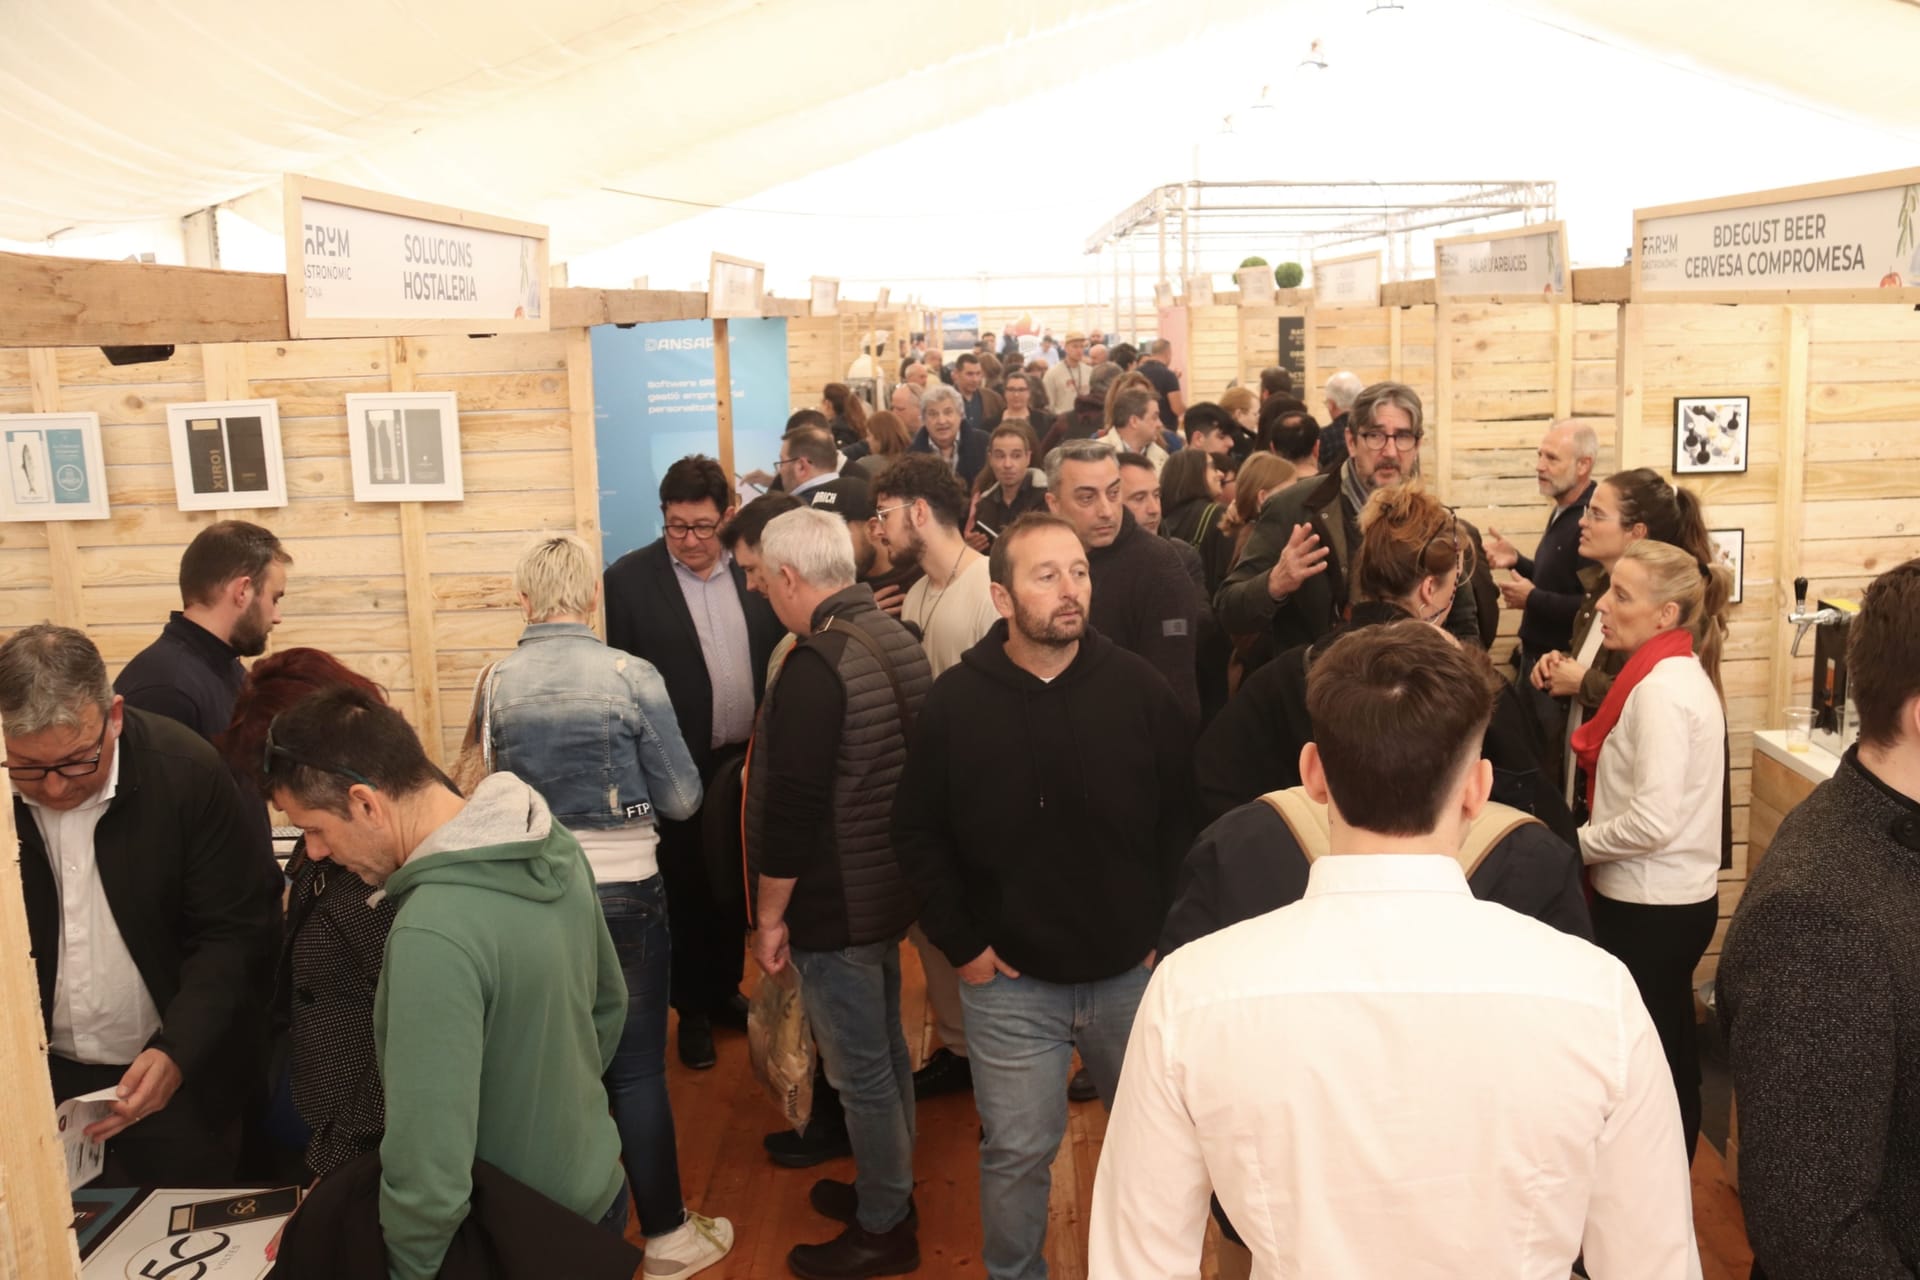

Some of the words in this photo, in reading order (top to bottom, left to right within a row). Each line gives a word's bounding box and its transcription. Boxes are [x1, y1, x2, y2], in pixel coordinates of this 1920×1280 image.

[1713, 219, 1780, 249] BDEGUST
[1784, 213, 1826, 243] BEER
[404, 234, 473, 268] SOLUCIONS
[1685, 253, 1743, 279] CERVESA
[1747, 244, 1866, 276] COMPROMESA
[403, 271, 477, 302] HOSTALERIA
[626, 802, 650, 818] FTP
